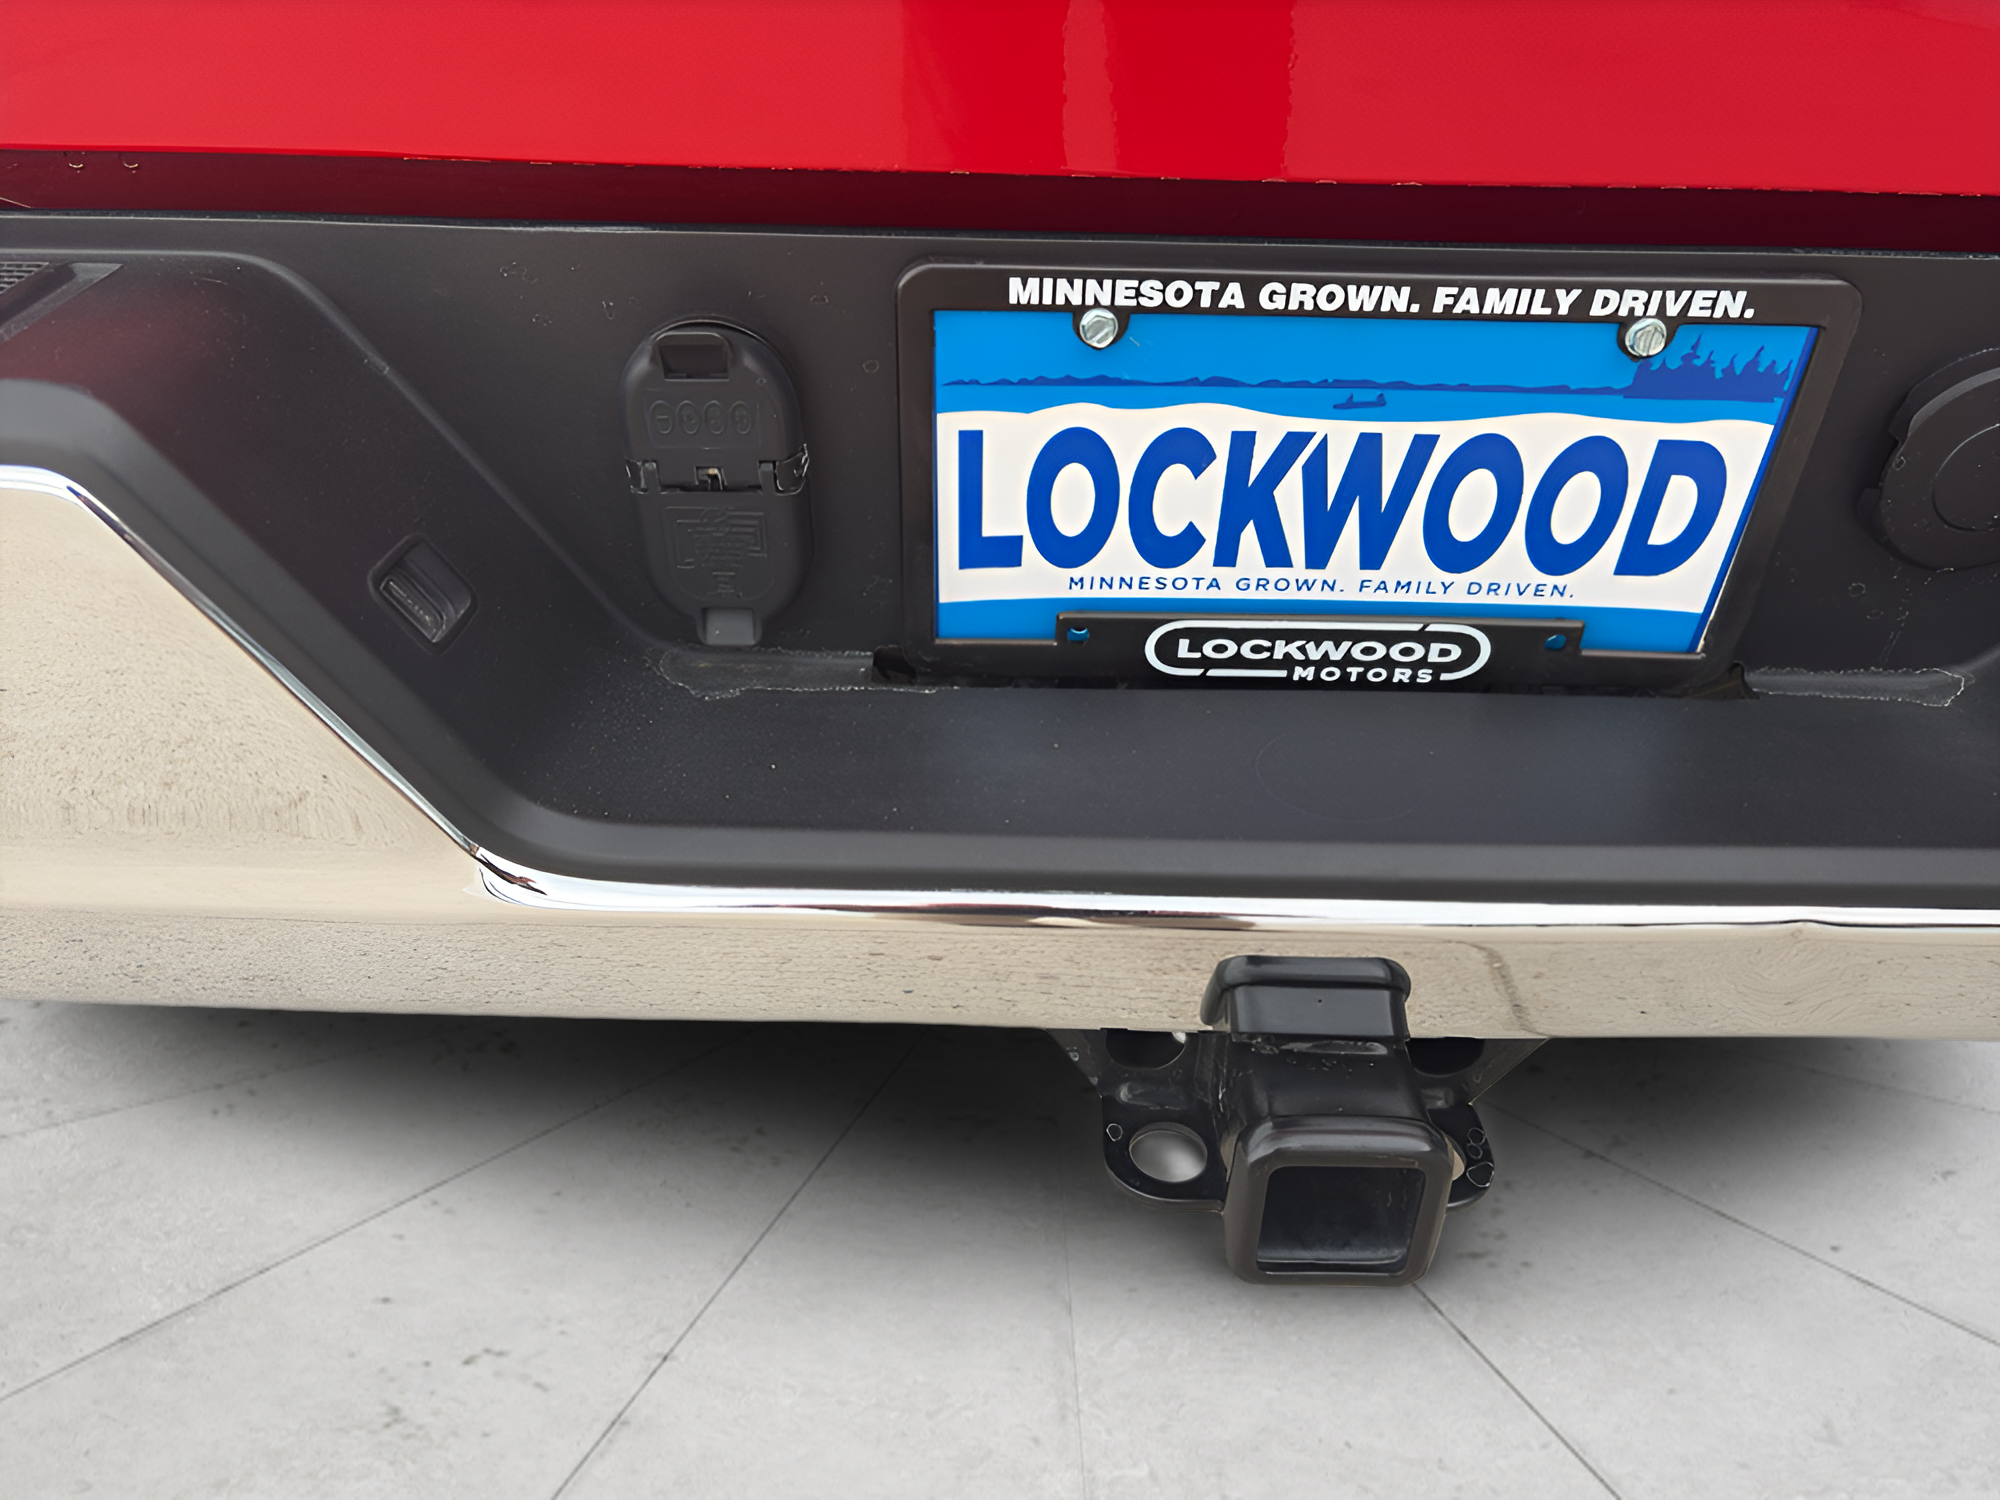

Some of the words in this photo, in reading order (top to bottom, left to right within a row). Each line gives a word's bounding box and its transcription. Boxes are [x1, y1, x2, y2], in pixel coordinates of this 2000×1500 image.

[1009, 277, 1246, 308] MINNESOTA
[1259, 282, 1421, 312] GROWN.
[1433, 287, 1583, 316] FAMILY
[1589, 289, 1755, 318] DRIVEN.
[958, 427, 1727, 576] LOCKWOOD
[1068, 576, 1221, 591] MINNESOTA
[1235, 577, 1344, 593] GROWN.
[1358, 579, 1455, 595] FAMILY
[1466, 581, 1575, 598] DRIVEN.
[1178, 638, 1462, 662] LOCKWOOD
[1292, 666, 1433, 683] MOTORS
